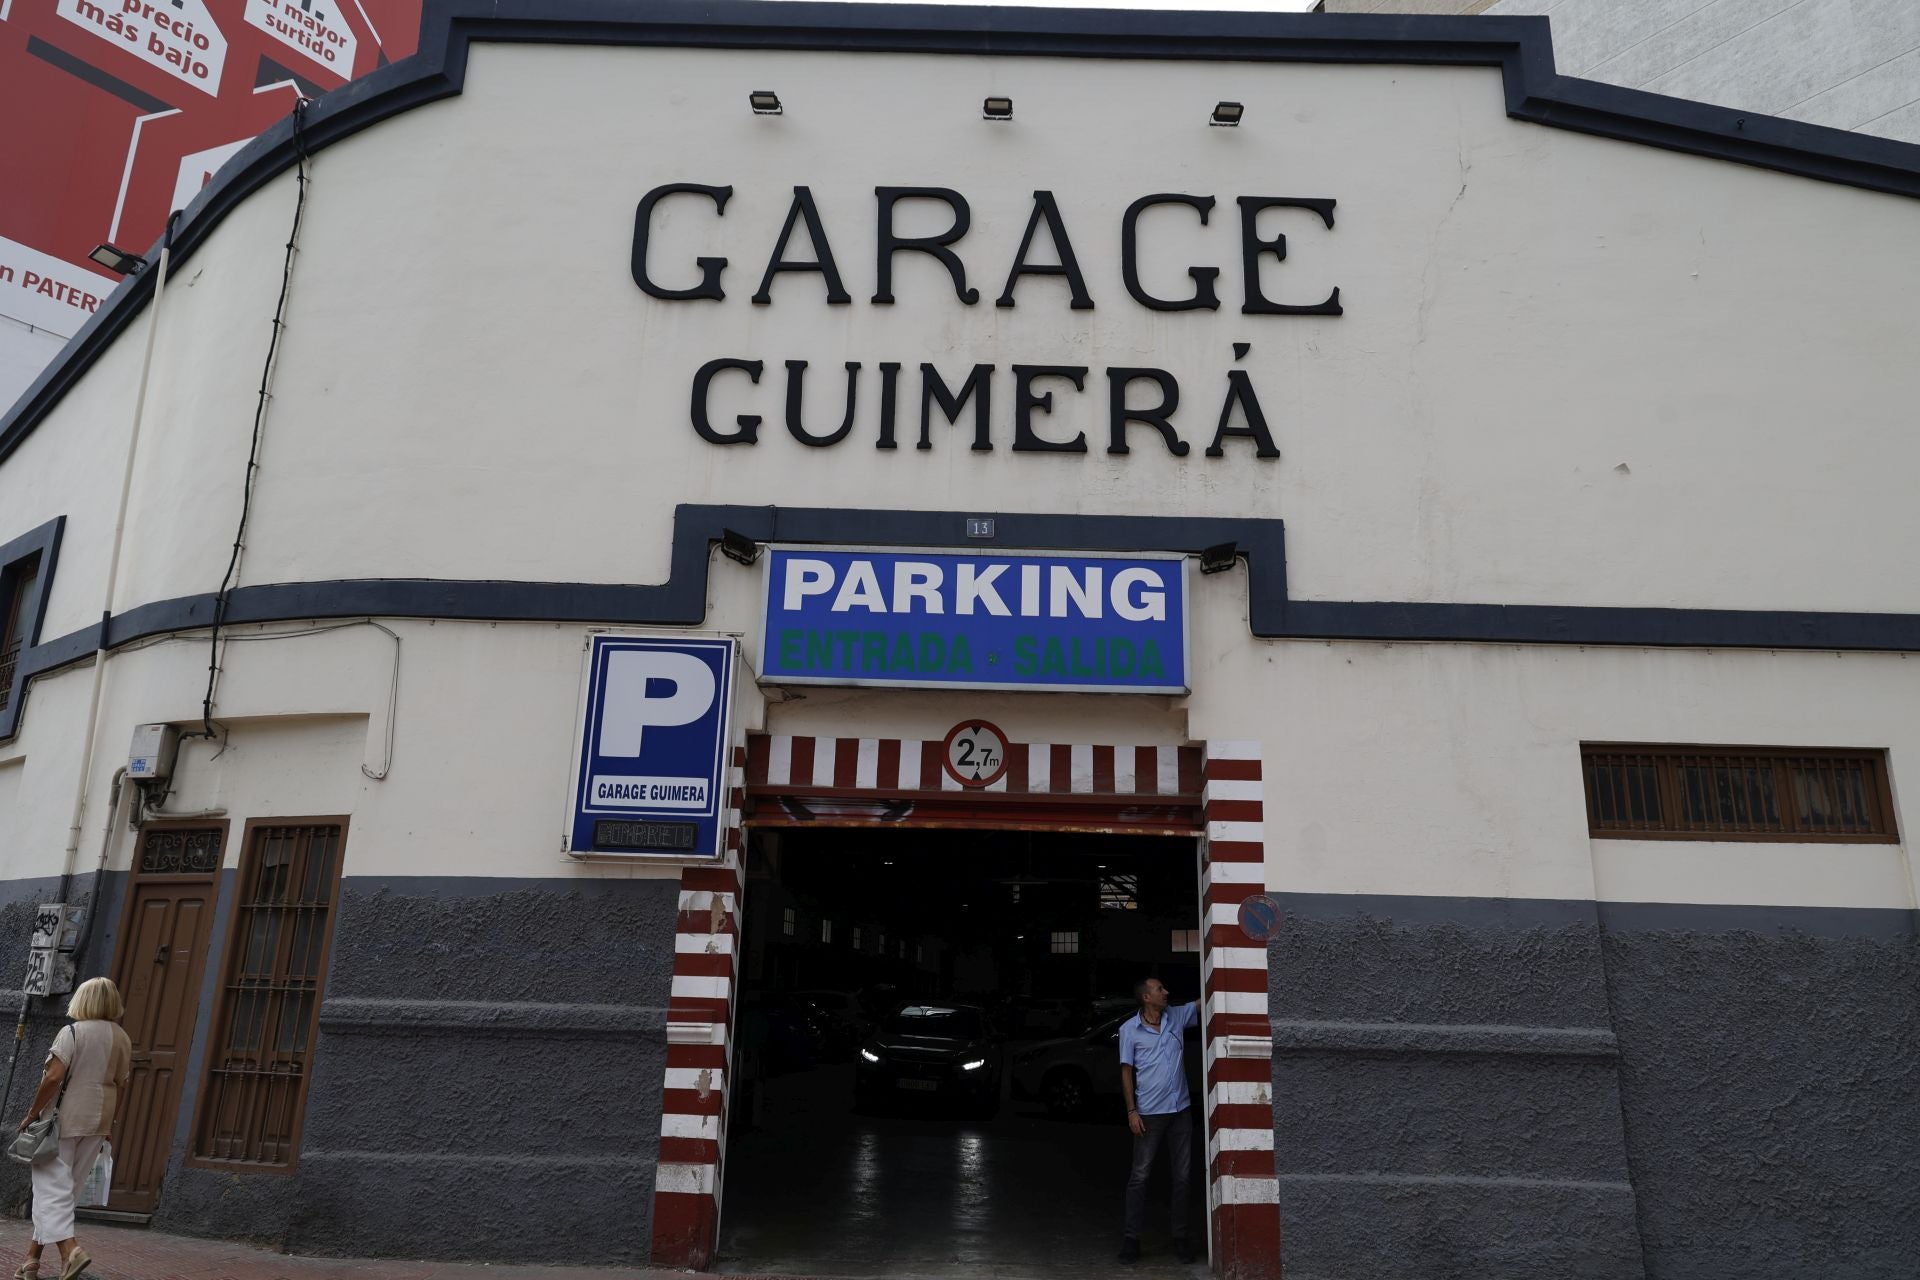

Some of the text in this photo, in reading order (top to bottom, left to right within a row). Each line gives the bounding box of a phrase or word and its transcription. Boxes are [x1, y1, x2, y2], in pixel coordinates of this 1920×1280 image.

[76, 0, 209, 79] más bajo
[122, 0, 210, 51] precio
[265, 13, 336, 62] surtido
[284, 4, 348, 49] mayor
[630, 182, 1344, 316] GARAGE
[22, 270, 105, 314] PATER
[690, 342, 1281, 460] GUIMERÁ
[973, 522, 988, 535] 13
[783, 558, 1166, 622] PARKING
[779, 630, 1166, 679] ENTRADA SALIDA
[598, 650, 716, 758] P
[598, 782, 705, 802] GARAGE GUIMERA
